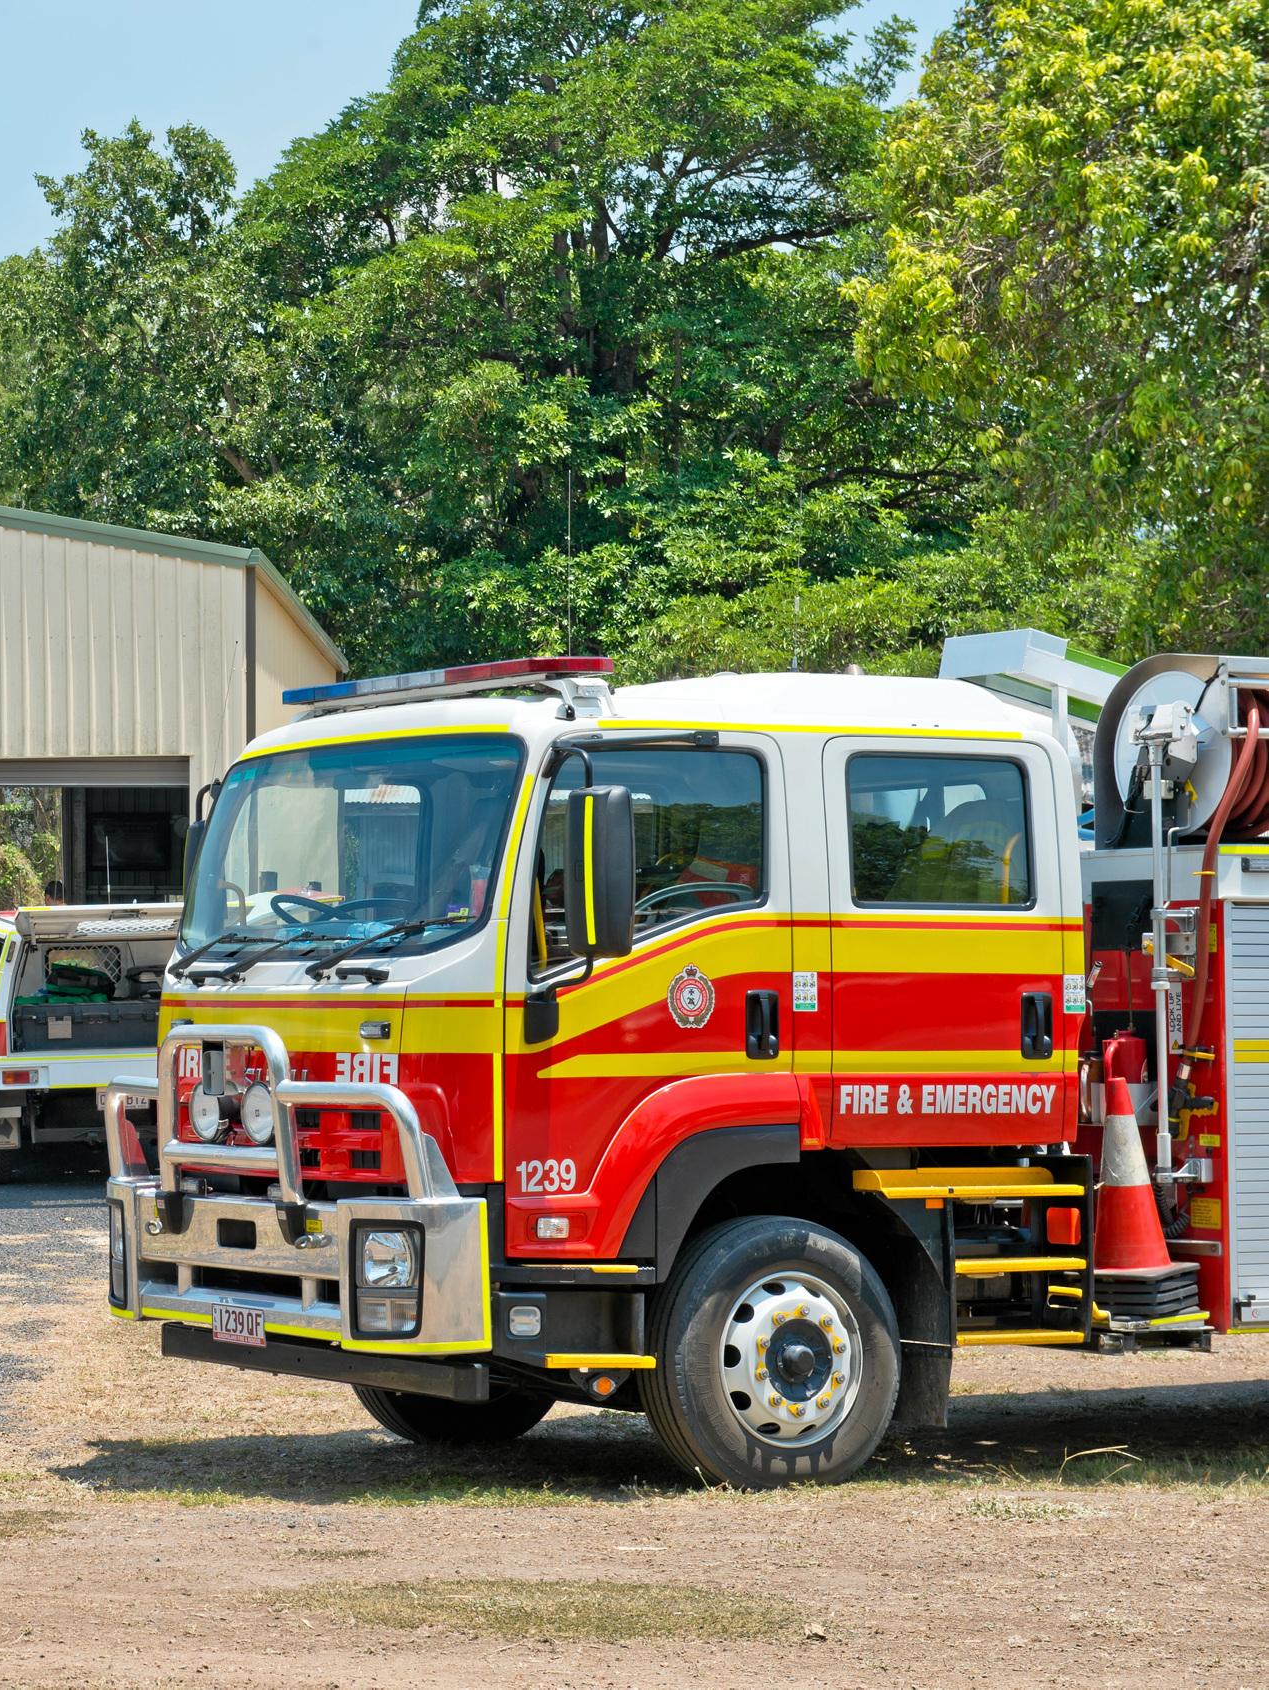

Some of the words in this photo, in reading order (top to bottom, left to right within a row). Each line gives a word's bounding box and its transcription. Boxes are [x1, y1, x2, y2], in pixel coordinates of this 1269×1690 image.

[1169, 993, 1174, 1004] UP
[840, 1085, 889, 1115] FIRE
[896, 1084, 913, 1114] &
[921, 1084, 1056, 1115] EMERGENCY
[516, 1159, 576, 1193] 1239
[220, 1309, 244, 1333] 1239
[247, 1312, 262, 1337] QF
